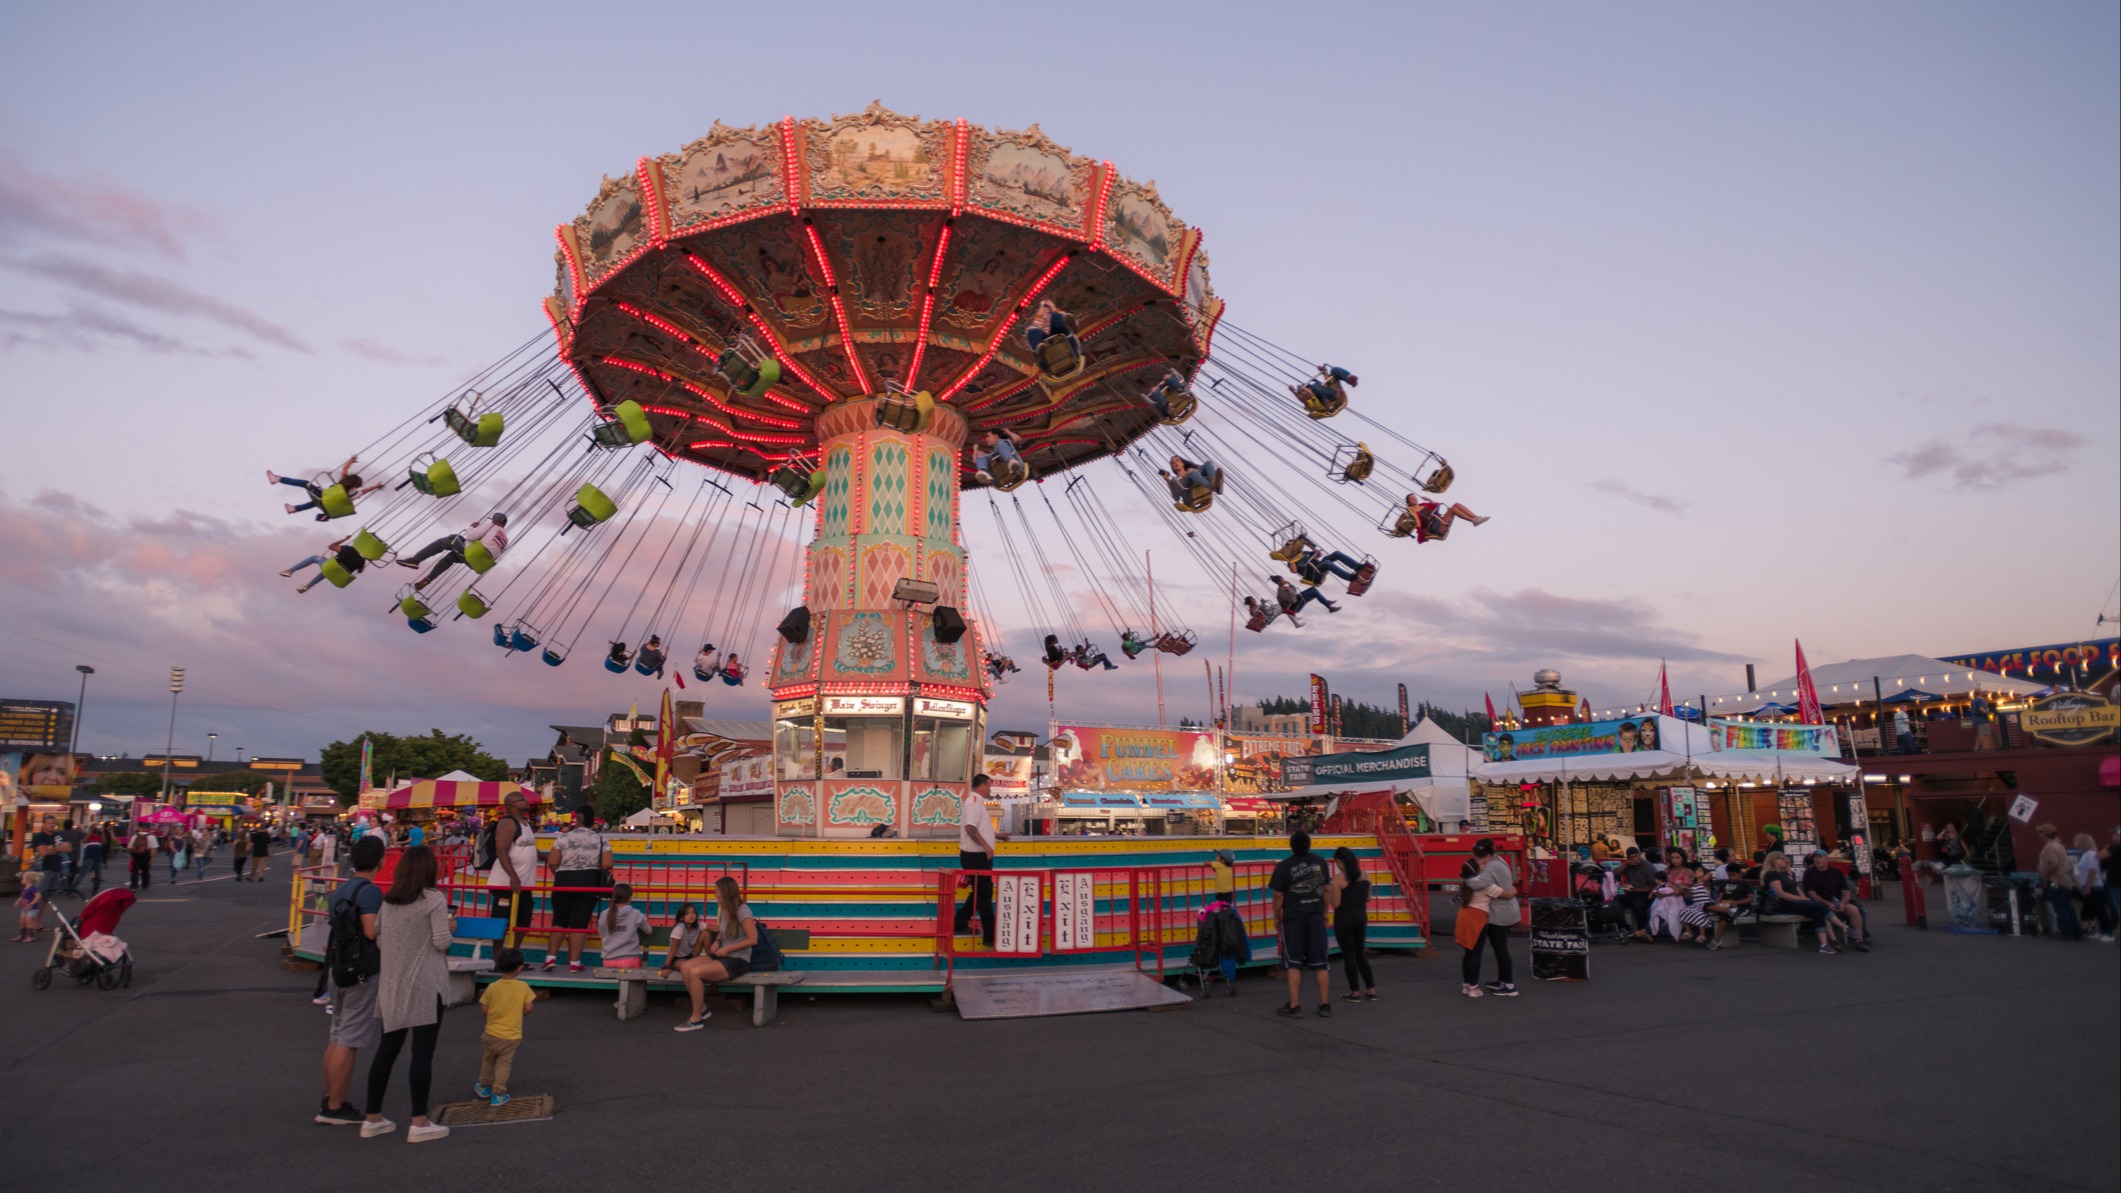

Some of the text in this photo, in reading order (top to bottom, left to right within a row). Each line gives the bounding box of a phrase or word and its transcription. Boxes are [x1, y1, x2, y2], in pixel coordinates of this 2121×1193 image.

[2030, 645, 2100, 668] FOOD
[859, 699, 898, 712] Swinger
[1311, 685, 1320, 725] FRIES
[2049, 697, 2088, 713] Village
[2028, 711, 2116, 727] Rooftop Bar
[1100, 734, 1179, 758] FUNNEL
[1243, 739, 1280, 759] EXTREME
[1283, 741, 1306, 757] FRIES
[1516, 734, 1616, 757] FACE PAINTING
[1727, 725, 1822, 752] FAIR HAIR!
[1106, 758, 1172, 782] CAKES
[1286, 765, 1311, 773] STATE
[1289, 773, 1307, 781] FAIR
[1315, 756, 1427, 776] OFFICIAL MERCHANDISE
[1002, 881, 1014, 947] Ausgang
[1022, 882, 1036, 946] Exit
[1059, 880, 1072, 943] Exit
[1080, 878, 1089, 944] Ausgang
